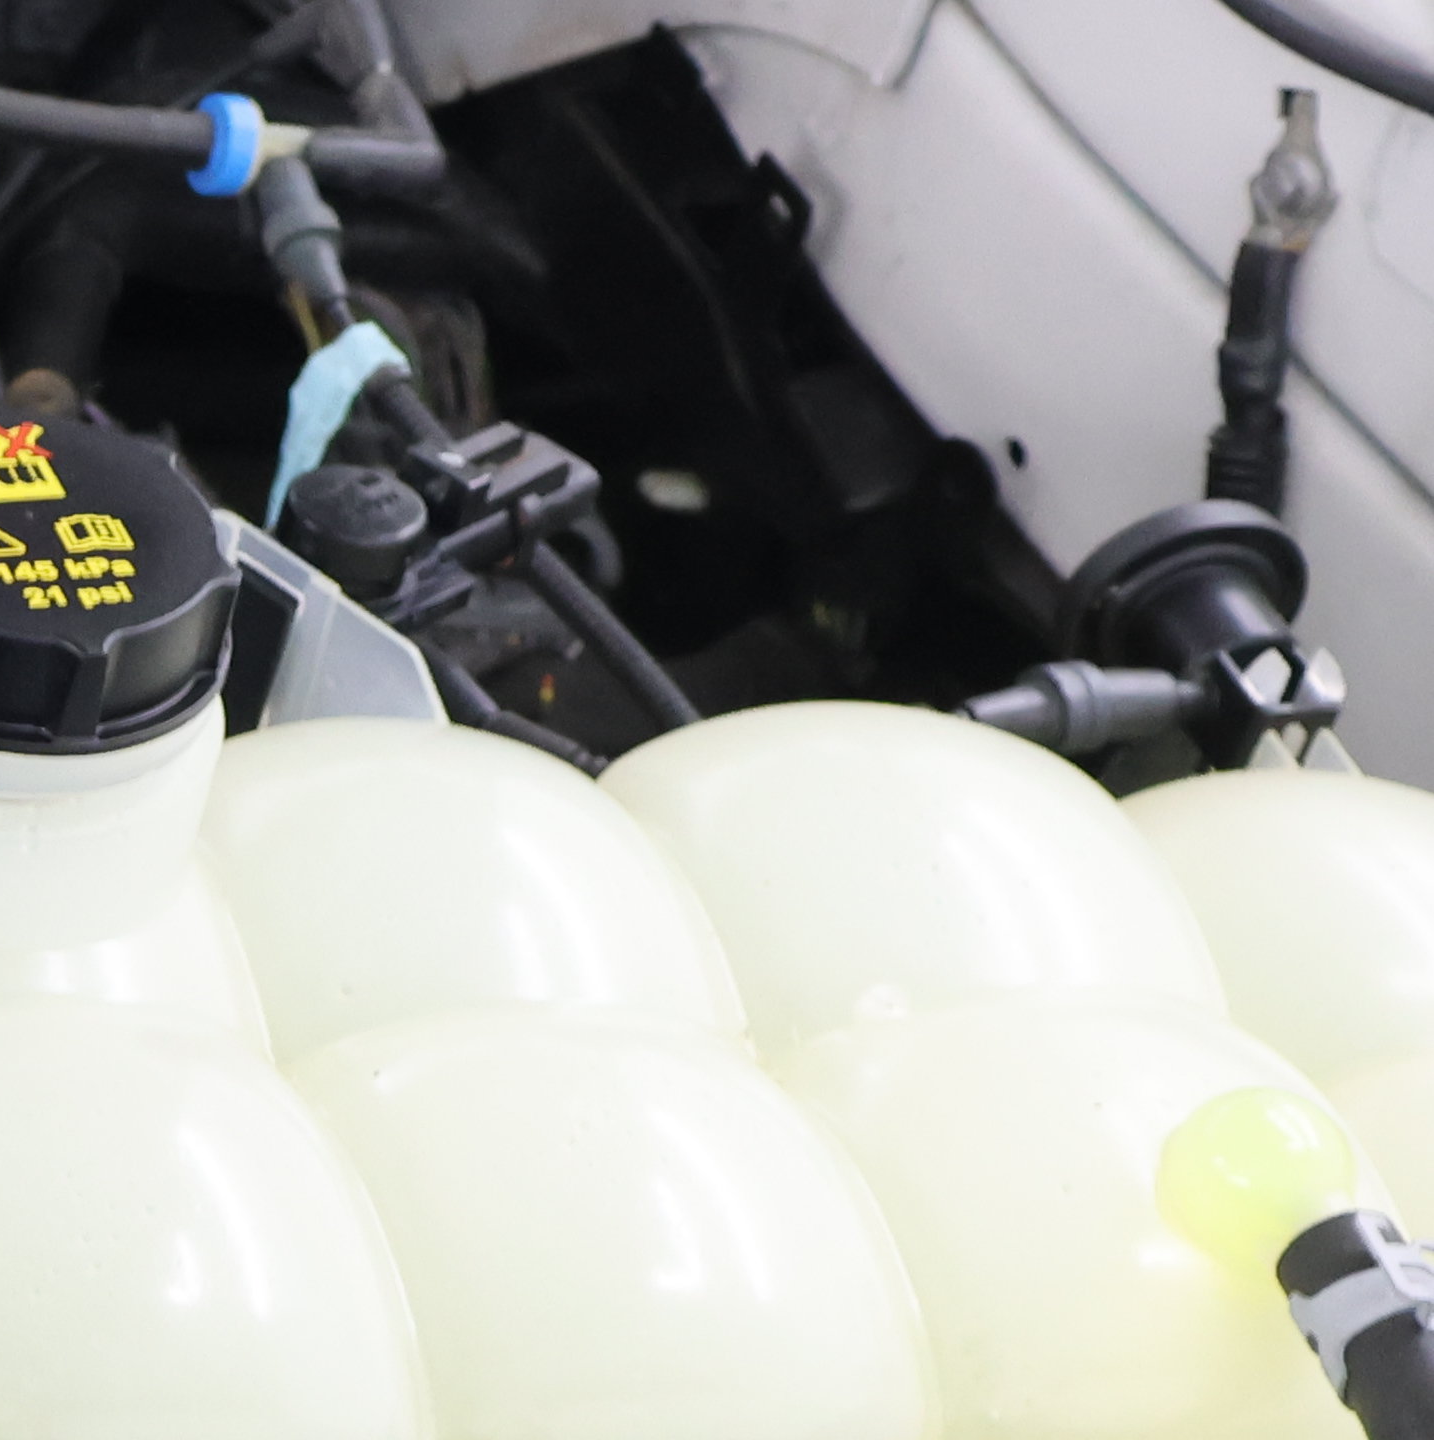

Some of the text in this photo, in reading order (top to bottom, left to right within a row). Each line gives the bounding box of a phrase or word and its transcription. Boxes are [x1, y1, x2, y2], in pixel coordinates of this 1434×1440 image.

[64, 555, 137, 581] kPa
[22, 580, 135, 611] 21 psi
